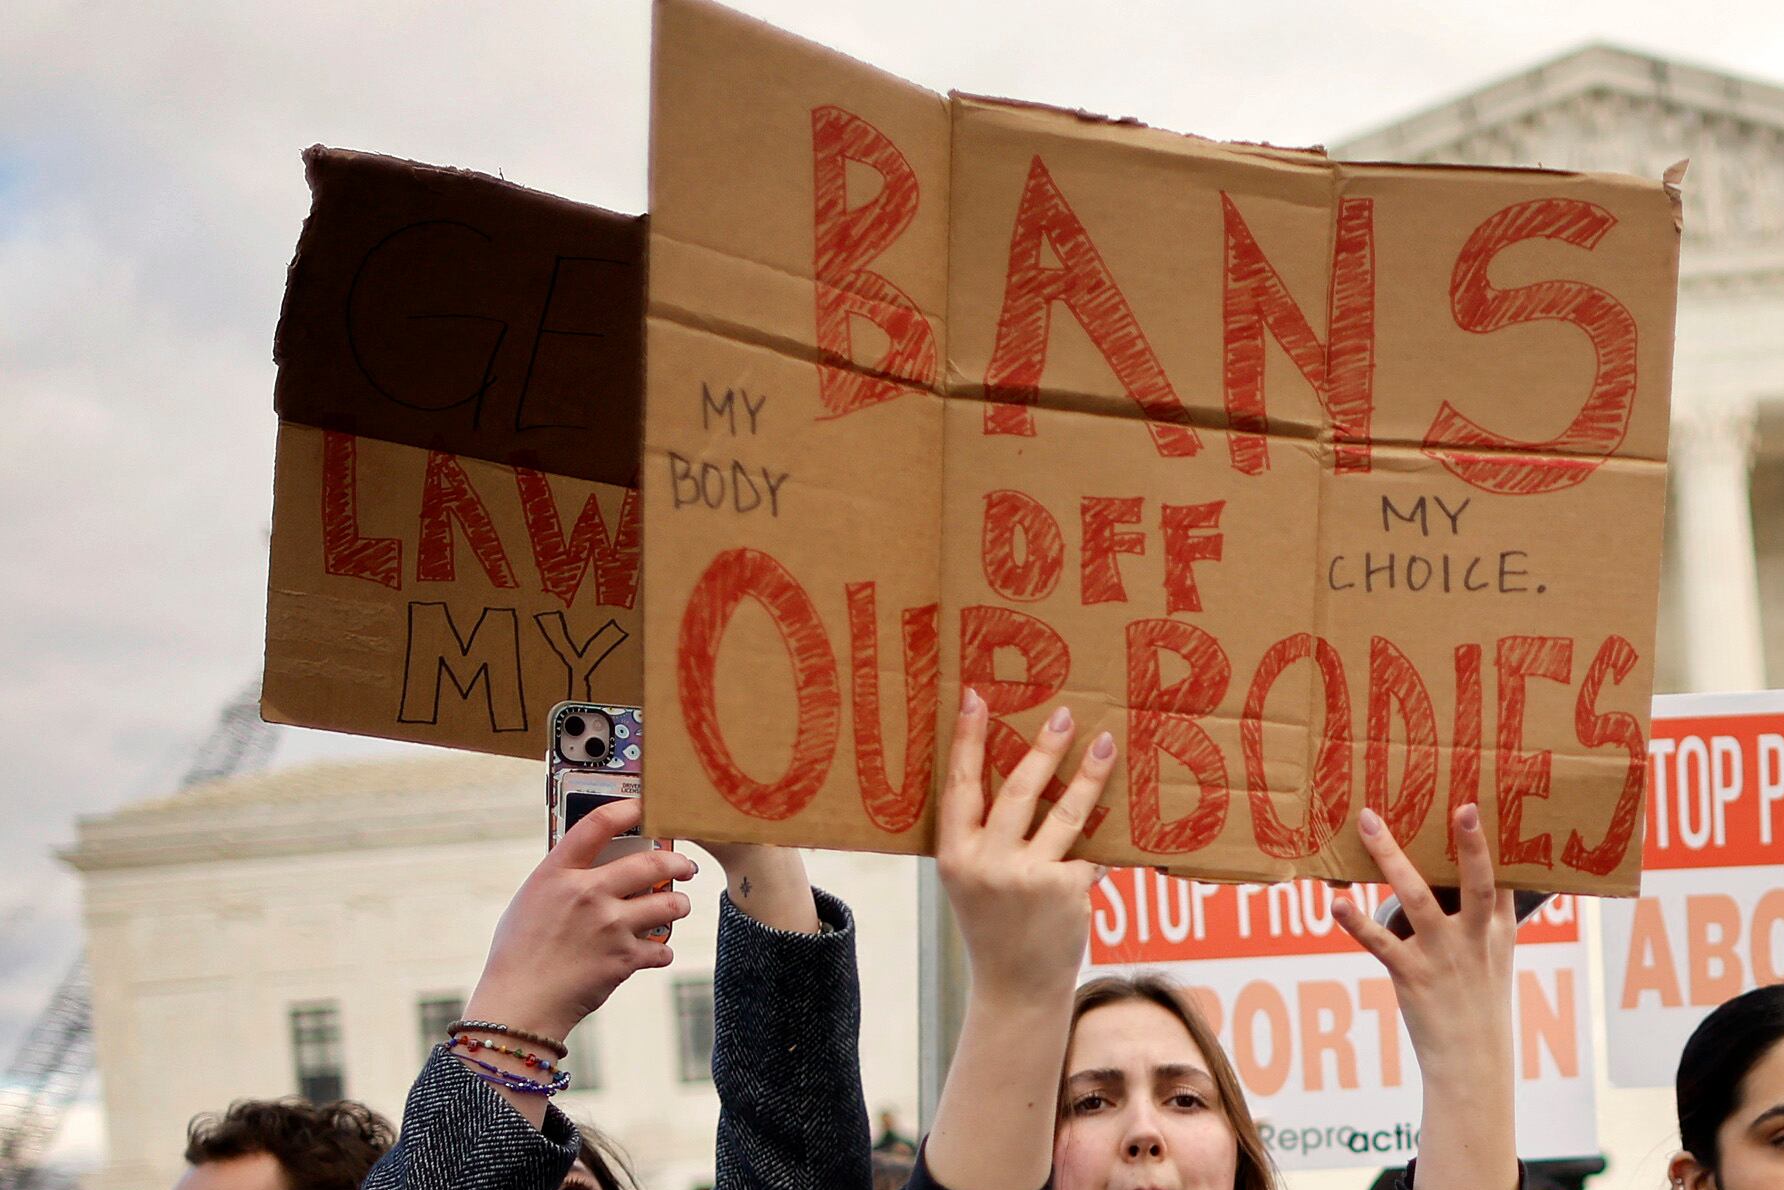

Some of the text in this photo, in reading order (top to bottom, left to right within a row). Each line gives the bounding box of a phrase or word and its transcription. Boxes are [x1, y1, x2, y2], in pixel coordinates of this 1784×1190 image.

[810, 105, 1639, 495] BANS
[702, 382, 767, 437] MY
[668, 450, 790, 519] BODY
[1381, 495, 1470, 536] MY
[982, 490, 1226, 615] OFF
[1328, 551, 1547, 595] CHOICE.
[397, 602, 629, 733] MY
[677, 546, 1646, 876] OUR BODIES
[1648, 735, 1744, 849] TOP
